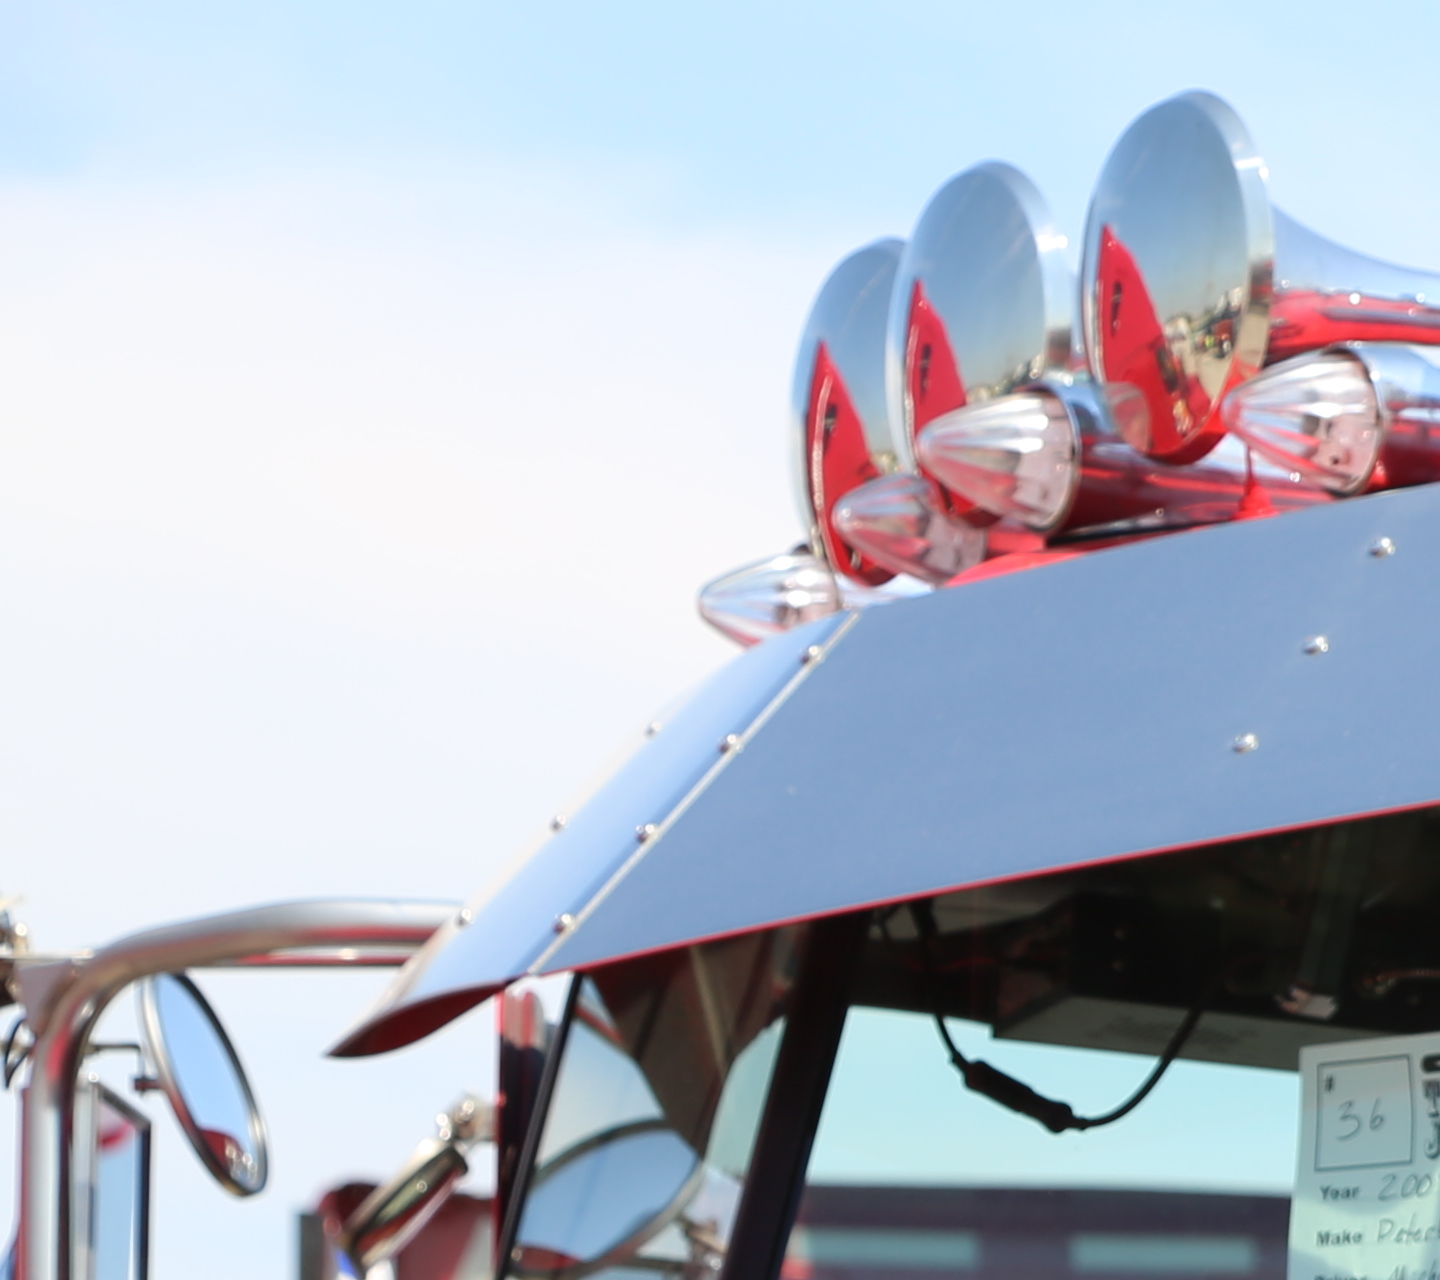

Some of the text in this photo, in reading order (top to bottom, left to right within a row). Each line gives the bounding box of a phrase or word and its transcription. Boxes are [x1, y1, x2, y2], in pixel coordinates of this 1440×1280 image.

[1336, 1097, 1386, 1141] 36
[1320, 1184, 1360, 1200] Year
[1316, 1230, 1363, 1247] Make
